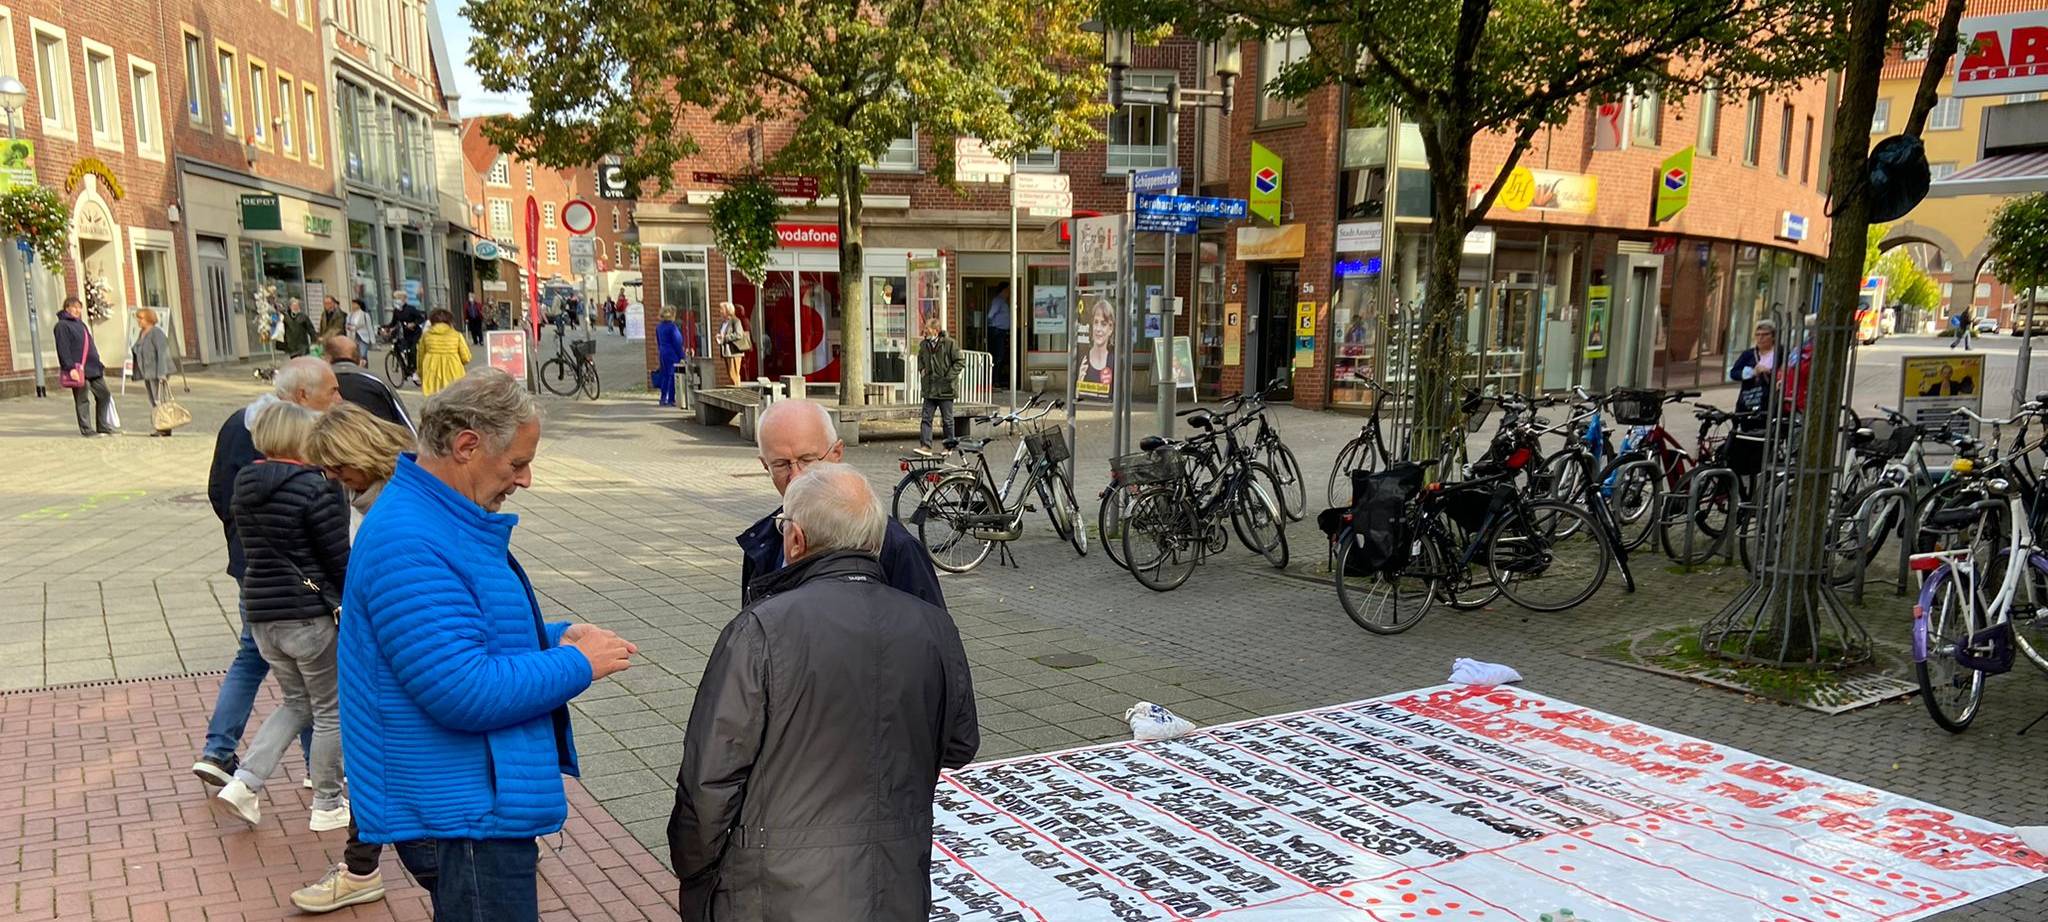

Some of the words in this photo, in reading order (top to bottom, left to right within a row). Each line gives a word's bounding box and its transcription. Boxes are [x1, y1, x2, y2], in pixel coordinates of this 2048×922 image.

[1134, 171, 1178, 189] Schüppenstraße
[242, 198, 276, 206] DEPOT
[1139, 196, 1243, 215] Bernhard-von-Galen-Straße
[777, 228, 837, 242] vodafone
[1231, 284, 1238, 294] 5
[1350, 703, 1418, 723] Mich
[1364, 776, 1445, 804] schon
[1175, 784, 1269, 821] Grunde
[1245, 821, 1291, 838] zu
[1246, 784, 1303, 807] oder
[1290, 806, 1421, 859] Interesse
[1106, 837, 1150, 853] zu
[1136, 850, 1211, 884] einem
[1264, 835, 1354, 873] wenig
[1176, 846, 1281, 893] meinem
